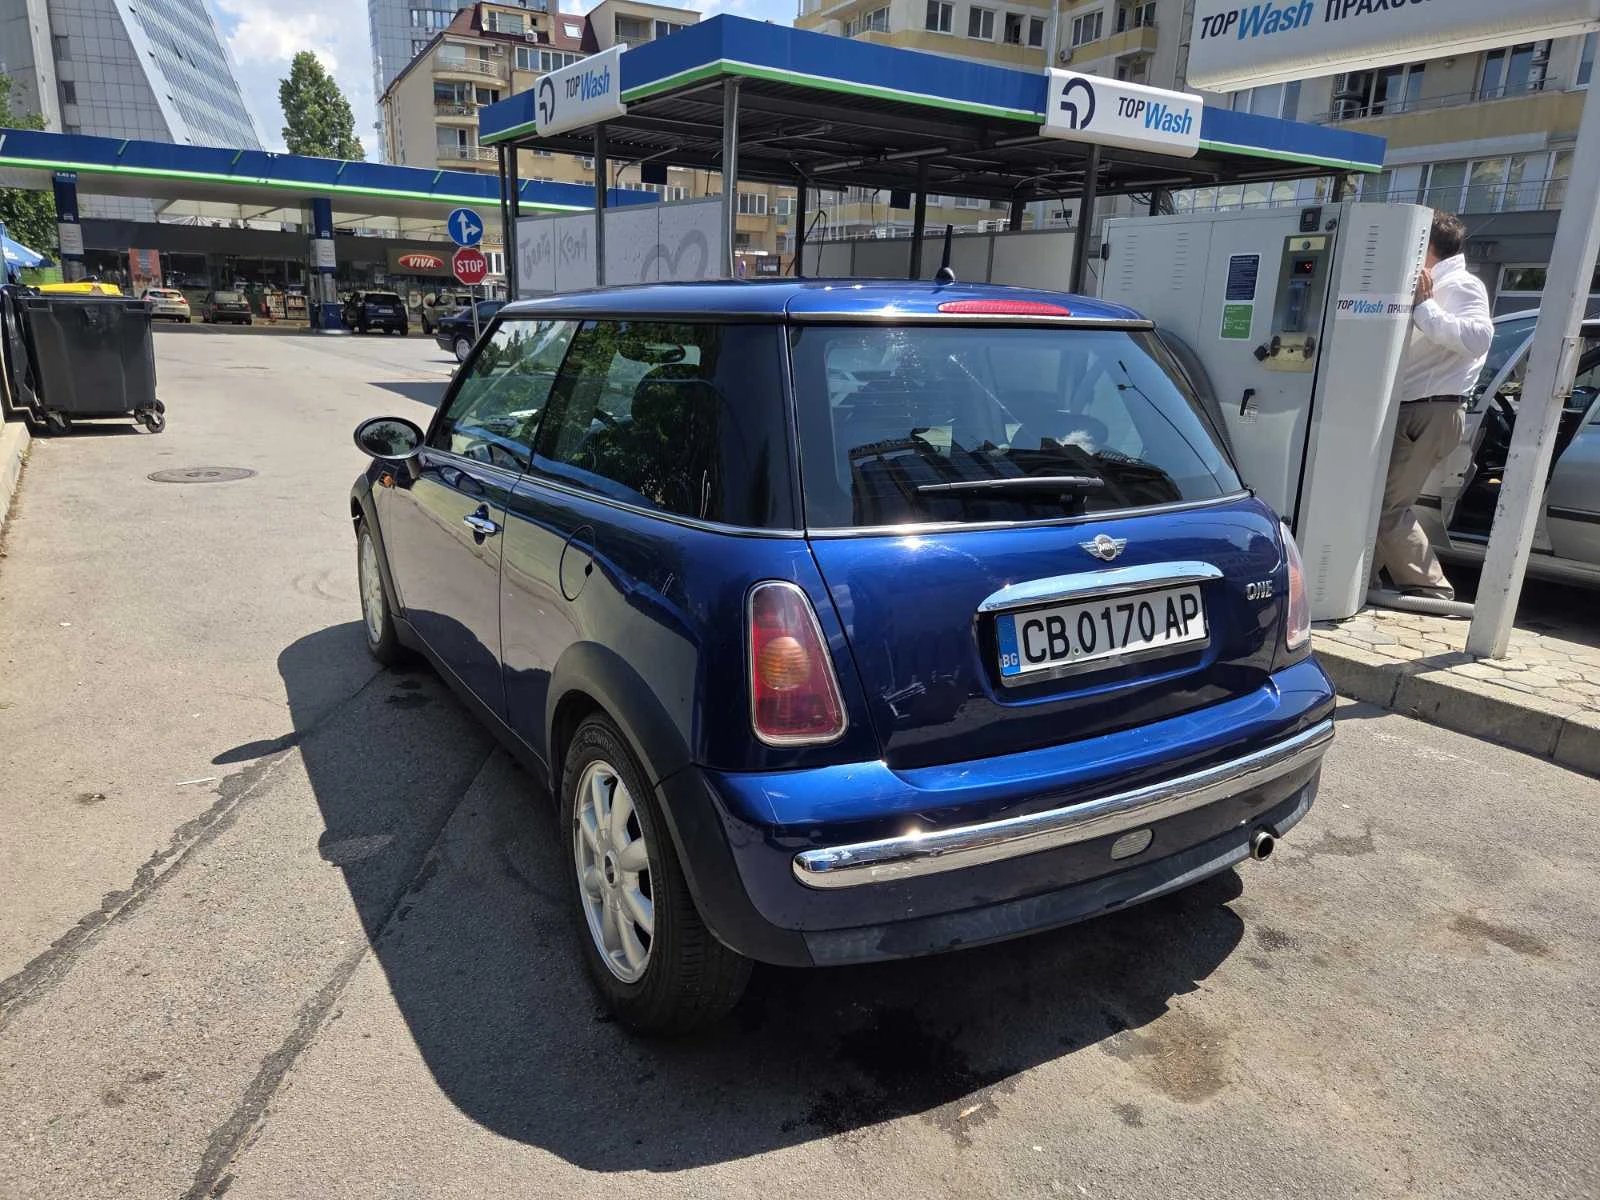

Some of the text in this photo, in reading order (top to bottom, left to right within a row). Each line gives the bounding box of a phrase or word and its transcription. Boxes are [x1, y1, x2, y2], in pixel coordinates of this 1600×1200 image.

[456, 261, 484, 273] STOP
[1246, 579, 1273, 600] ONE
[1077, 601, 1156, 654] 0170
[1164, 593, 1199, 640] AP
[1001, 652, 1018, 668] BG
